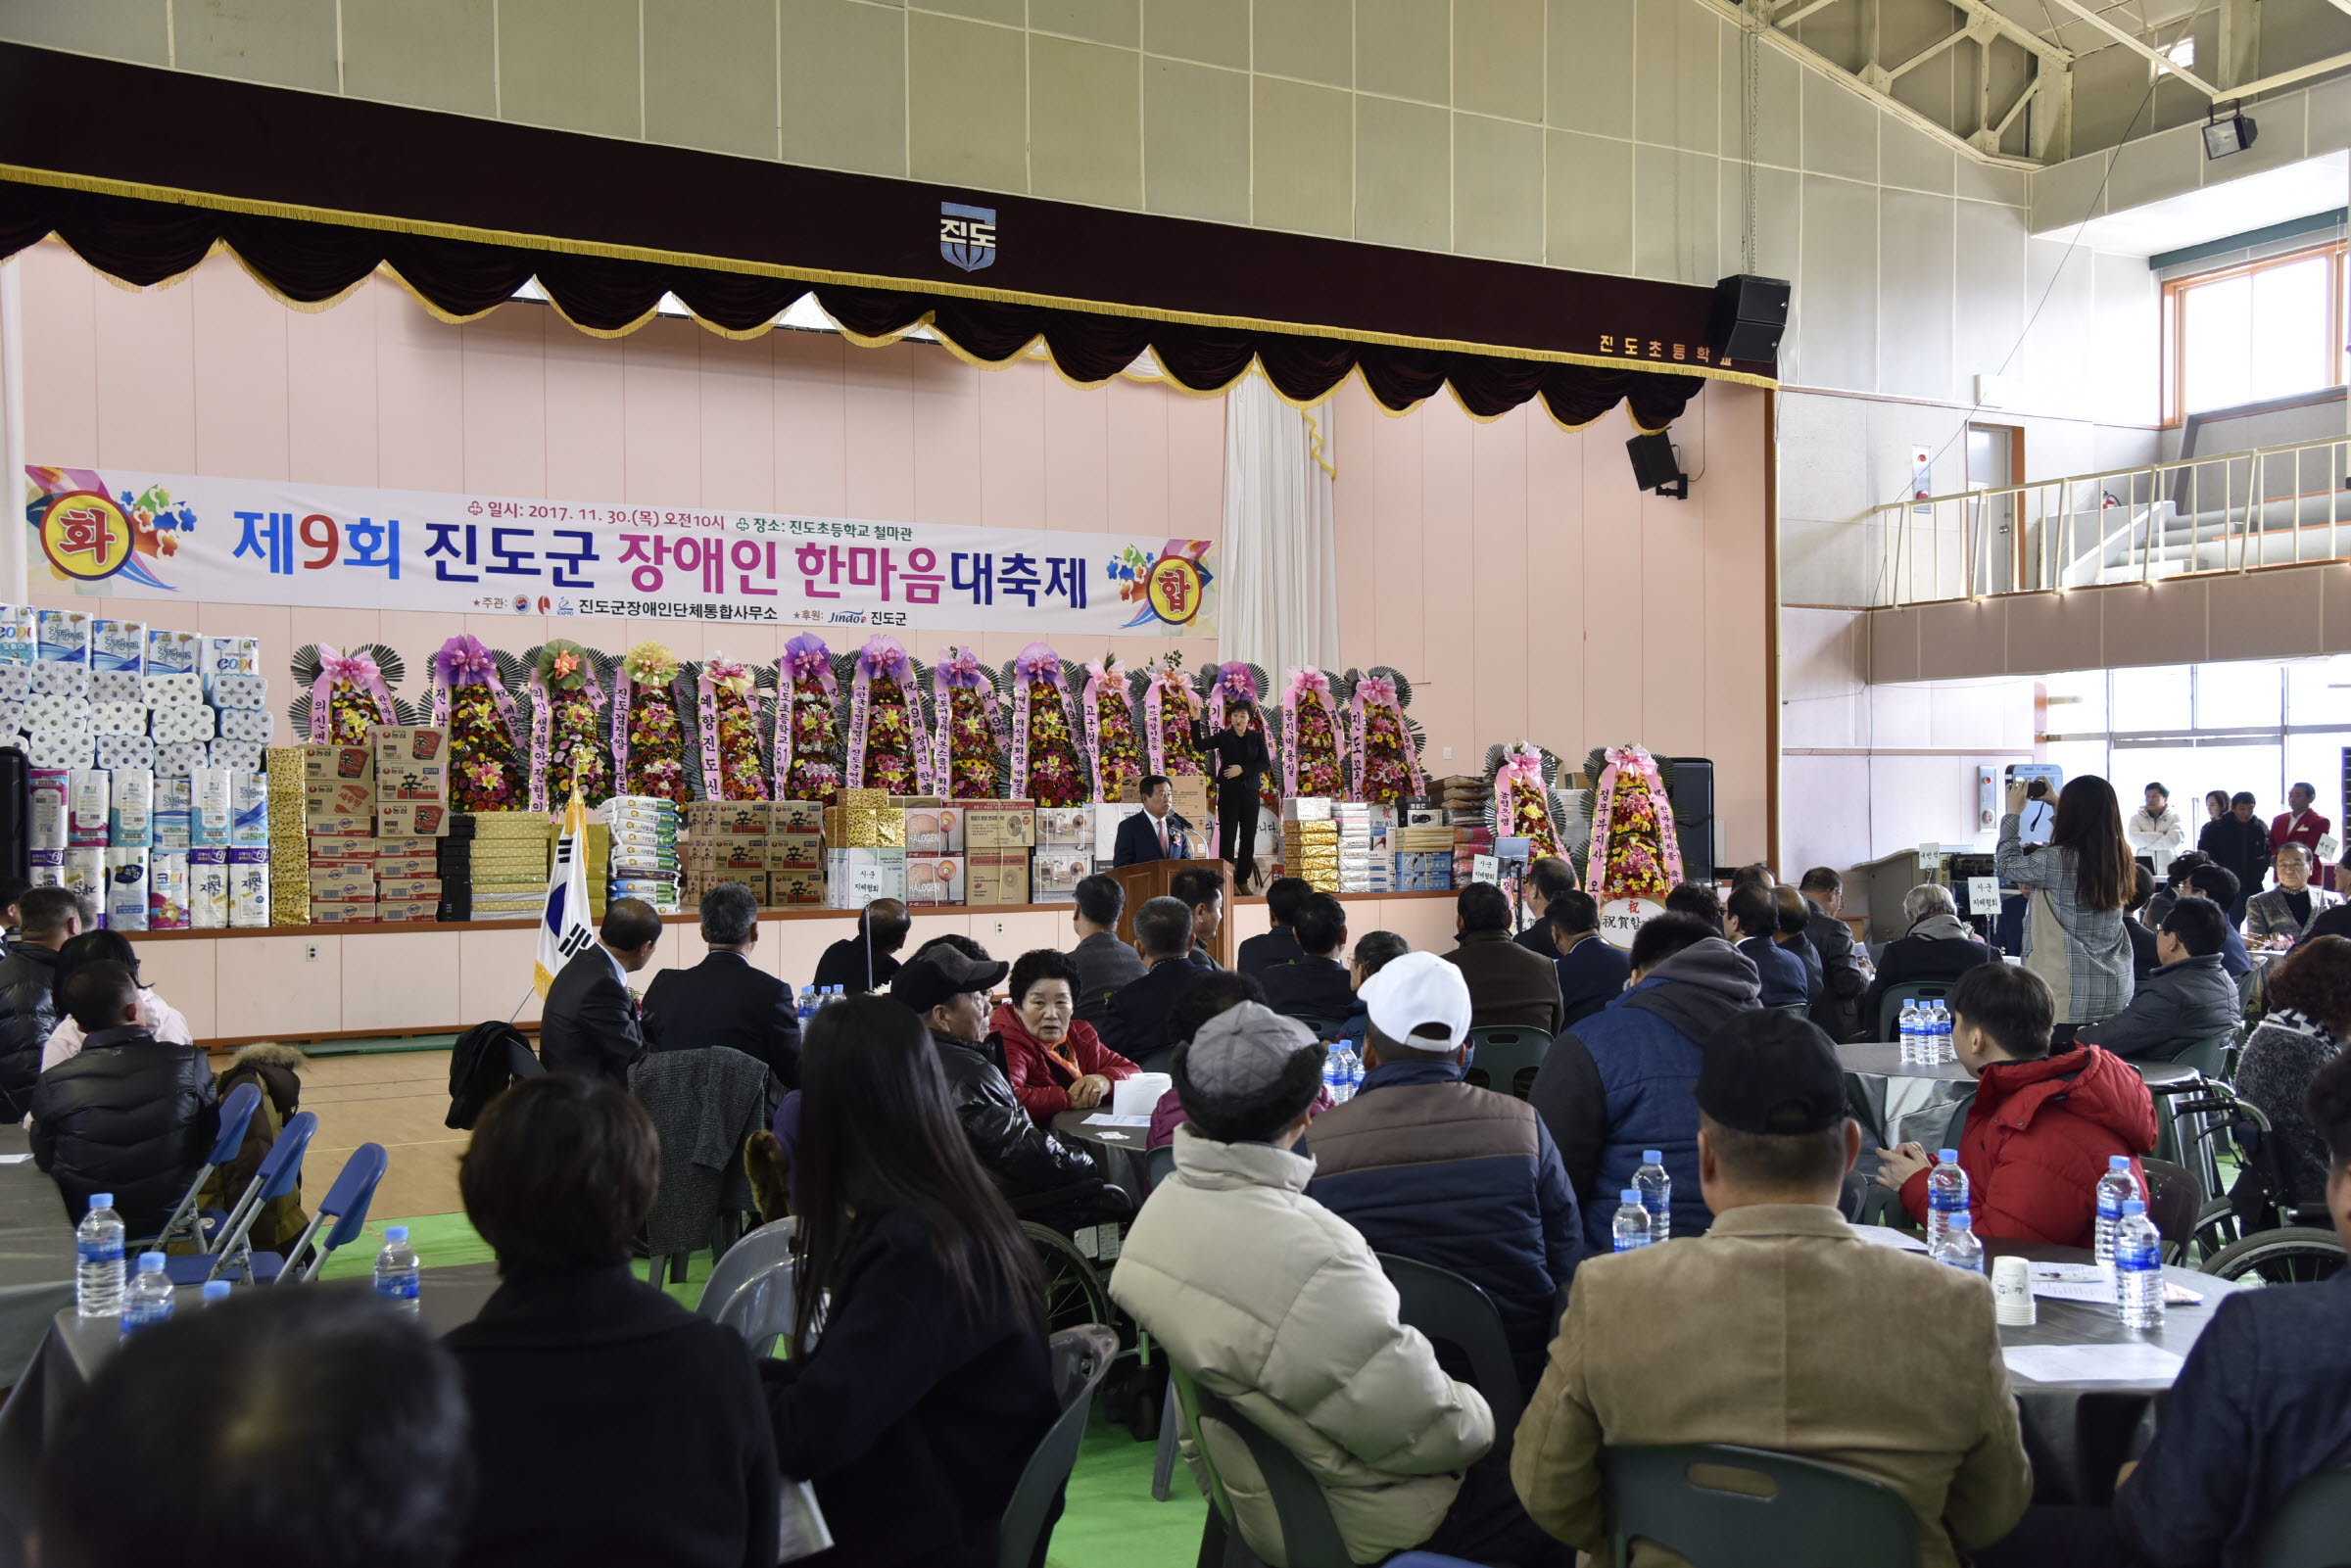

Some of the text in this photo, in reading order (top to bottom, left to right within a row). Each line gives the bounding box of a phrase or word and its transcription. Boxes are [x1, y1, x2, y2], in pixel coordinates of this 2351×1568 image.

[940, 218, 996, 248] 진도
[57, 506, 117, 565] 화
[488, 501, 913, 542] 일시: 2017. 11. 30.(목) 오전10시 장소: 진도초등학교 철마관
[231, 510, 400, 581] 제9회
[424, 522, 600, 589] 진도군
[617, 533, 778, 596] 장애인
[1157, 567, 1191, 613] 합
[483, 596, 507, 608] 주관:
[579, 599, 778, 620] 진도군장애인단체통합사무소
[801, 610, 824, 621] 후원:
[871, 611, 907, 626] 진도군
[401, 772, 423, 800] 辛
[908, 833, 939, 842] HALOGEN
[1592, 788, 1609, 862] 정무부지사
[908, 883, 940, 892] HALOGEN
[1627, 900, 1640, 914] 祝
